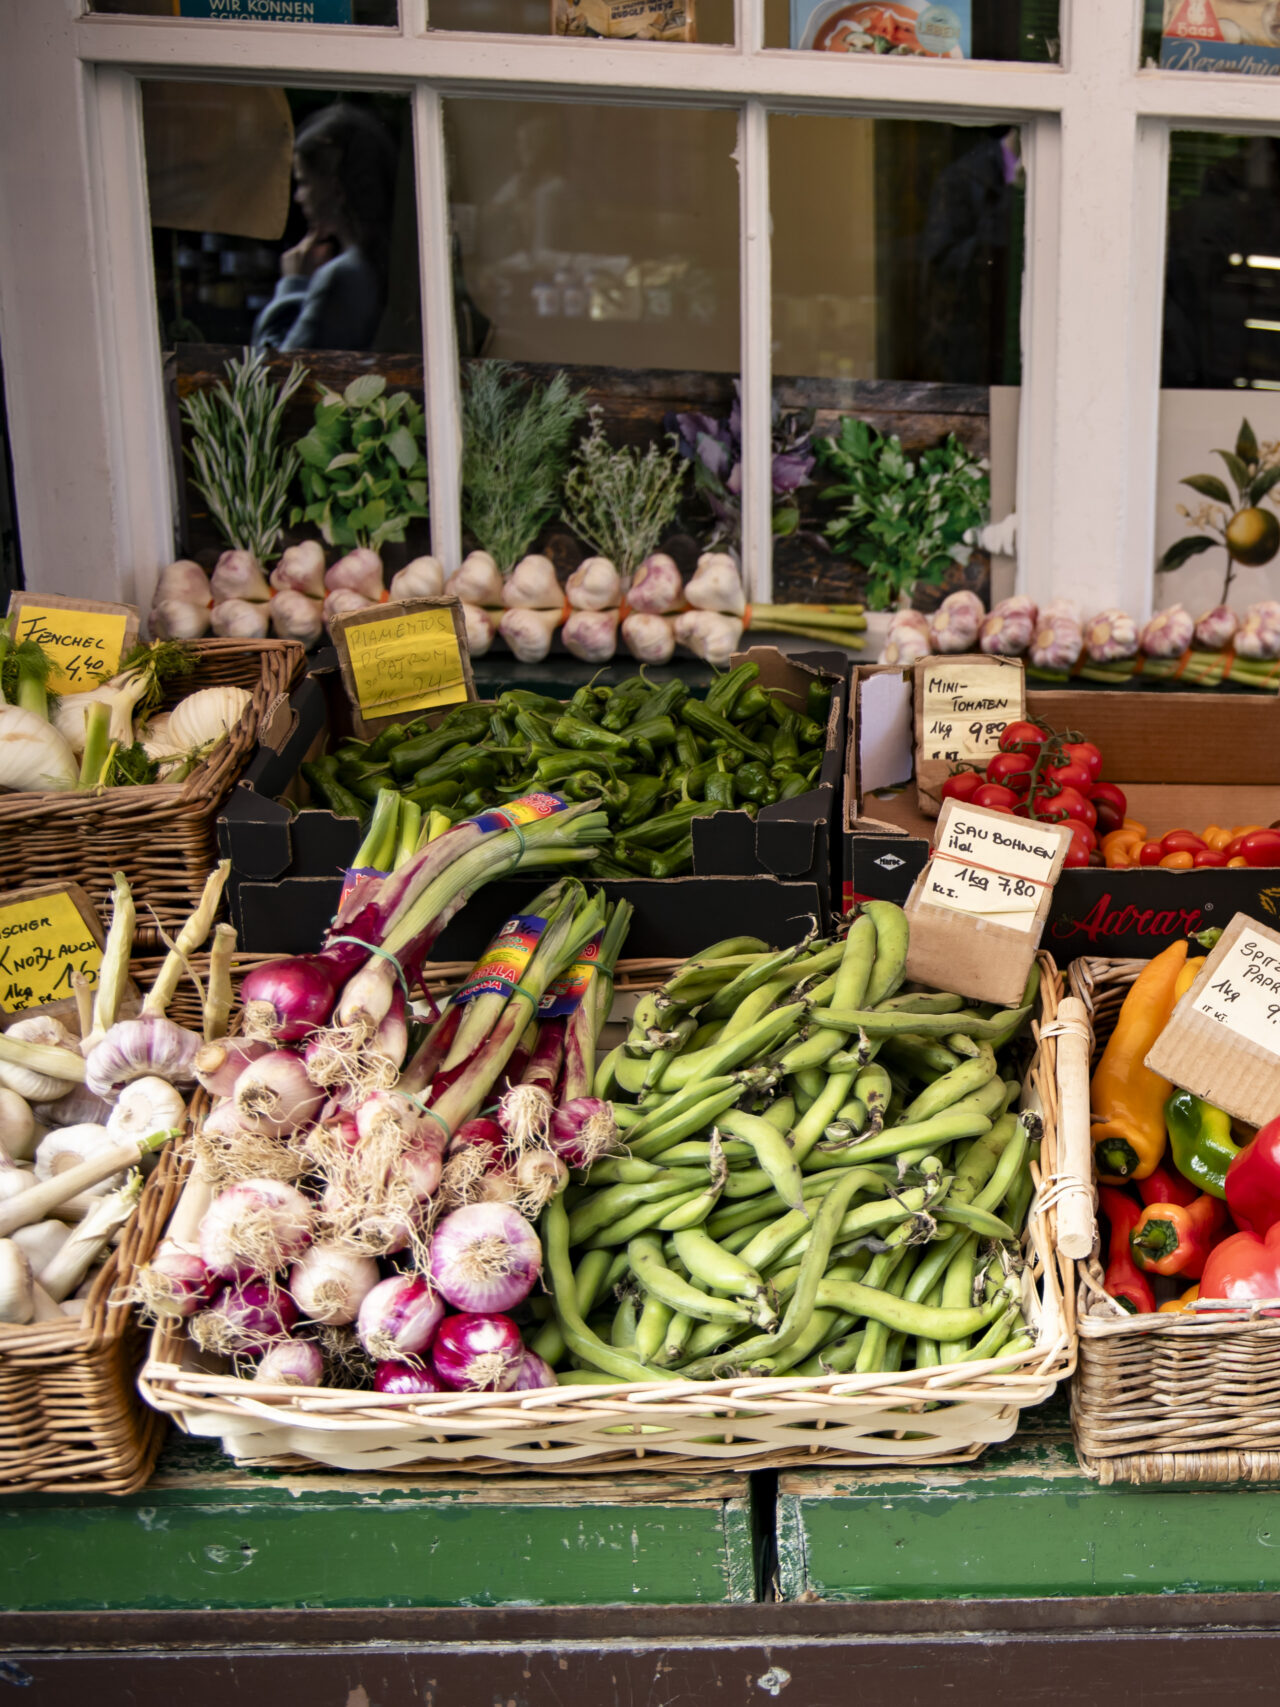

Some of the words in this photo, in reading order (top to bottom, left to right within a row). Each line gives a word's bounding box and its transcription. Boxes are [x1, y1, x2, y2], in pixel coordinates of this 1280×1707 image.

[208, 0, 241, 11] WIR
[21, 616, 105, 650] FENCHEL
[928, 677, 968, 693] MINI-
[951, 695, 1008, 712] TOMATEN
[930, 721, 953, 740] 1kg
[954, 868, 989, 892] 1kg
[997, 875, 1037, 898] 7,80
[1051, 893, 1203, 943] Adrar
[4, 983, 33, 1001] 1kg
[1210, 979, 1241, 1004] 1kg
